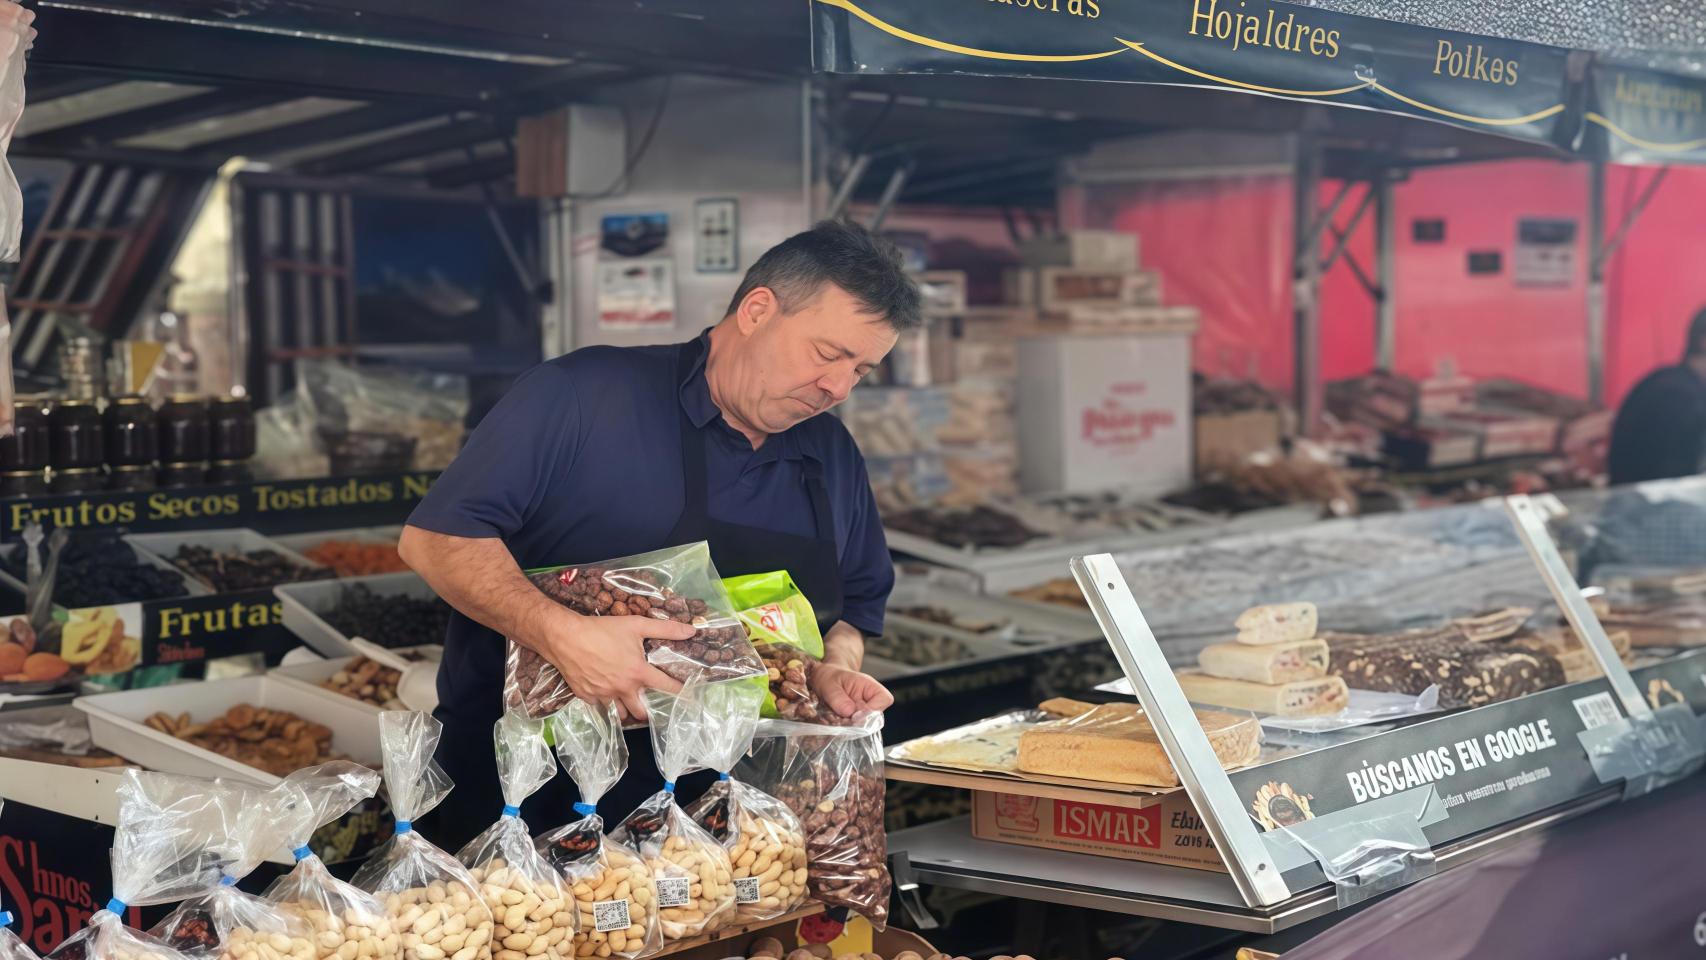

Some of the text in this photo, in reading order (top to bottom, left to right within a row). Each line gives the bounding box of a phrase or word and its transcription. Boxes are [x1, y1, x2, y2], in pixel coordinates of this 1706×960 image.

[1189, 0, 1341, 59] Hojaldres
[10, 500, 137, 531] Frutos
[148, 491, 240, 521] Secos
[253, 480, 394, 512] Tostados
[159, 602, 283, 639] Frutas
[1454, 737, 1487, 772] EN
[1484, 718, 1557, 763] GOOGLE
[1060, 804, 1154, 846] ISMAR
